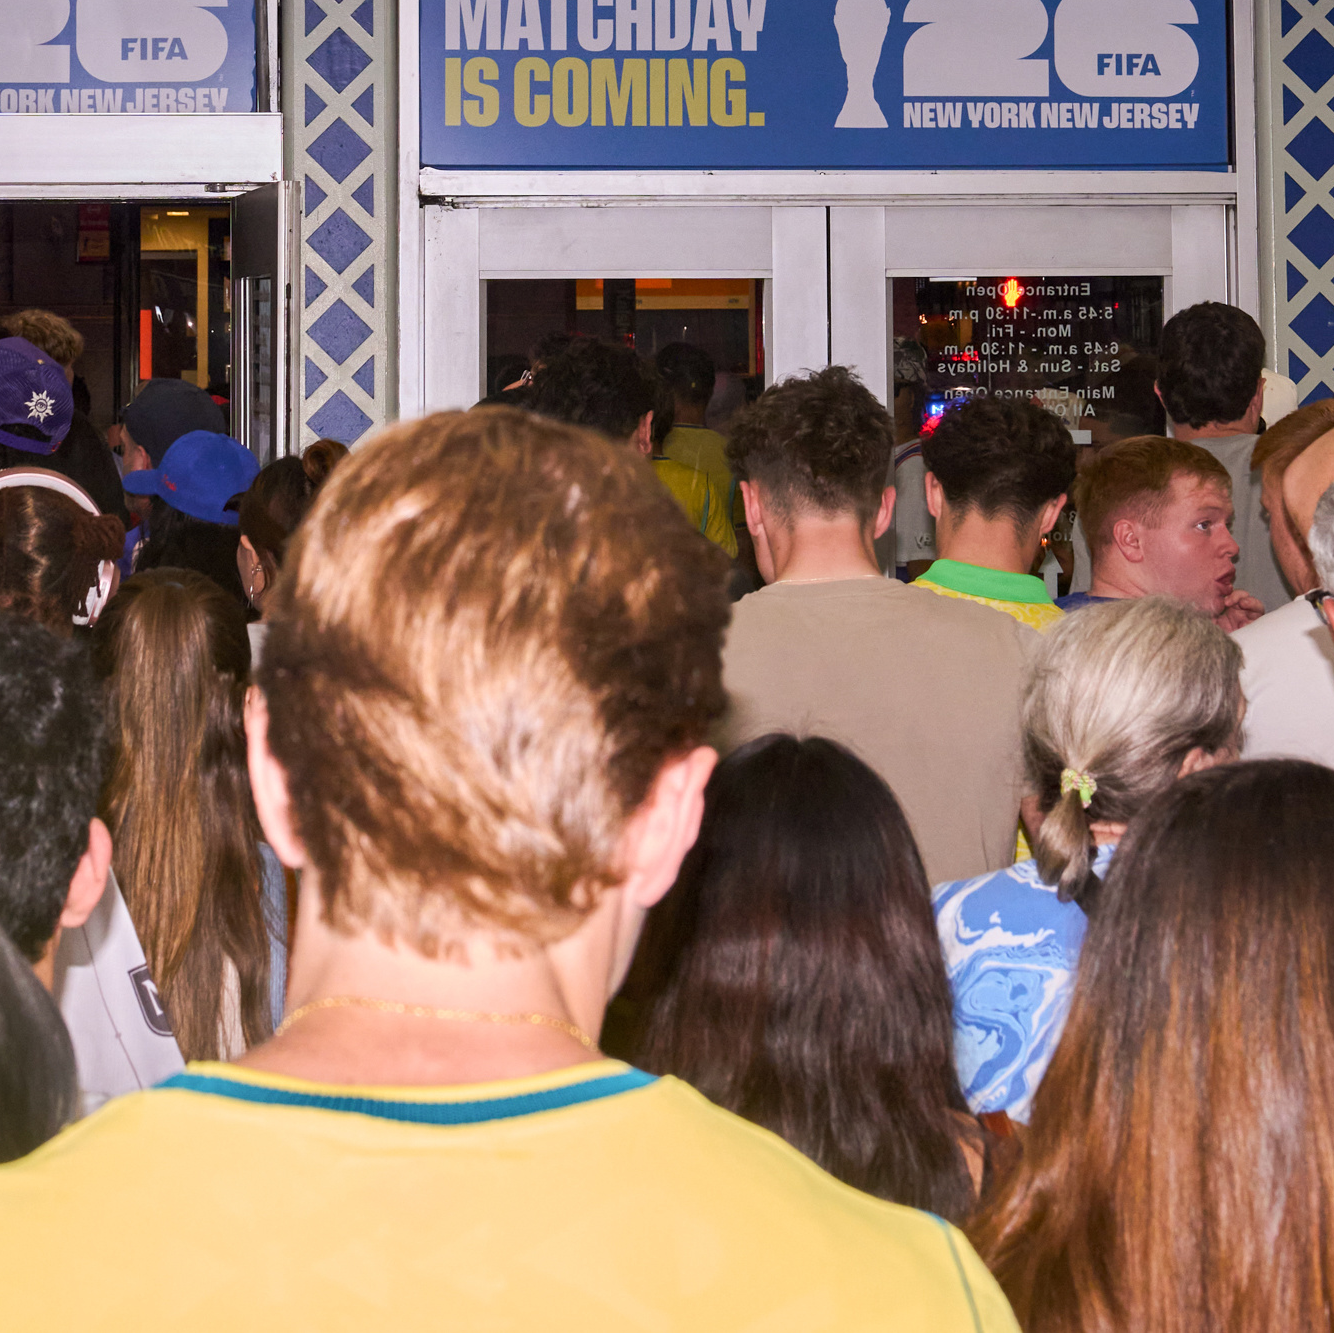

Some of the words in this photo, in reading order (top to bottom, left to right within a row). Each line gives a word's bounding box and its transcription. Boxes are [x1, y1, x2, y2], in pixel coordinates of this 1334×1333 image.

[121, 37, 188, 61] FIFA
[1097, 53, 1161, 76] FIFA
[60, 88, 125, 113] NEW
[126, 88, 229, 113] JERSEY
[445, 58, 500, 127] IS
[514, 57, 765, 127] COMING.
[904, 102, 963, 128] NEW
[966, 102, 1036, 128] YORK
[1041, 103, 1100, 128] NEW
[1102, 103, 1200, 129] JERSEY
